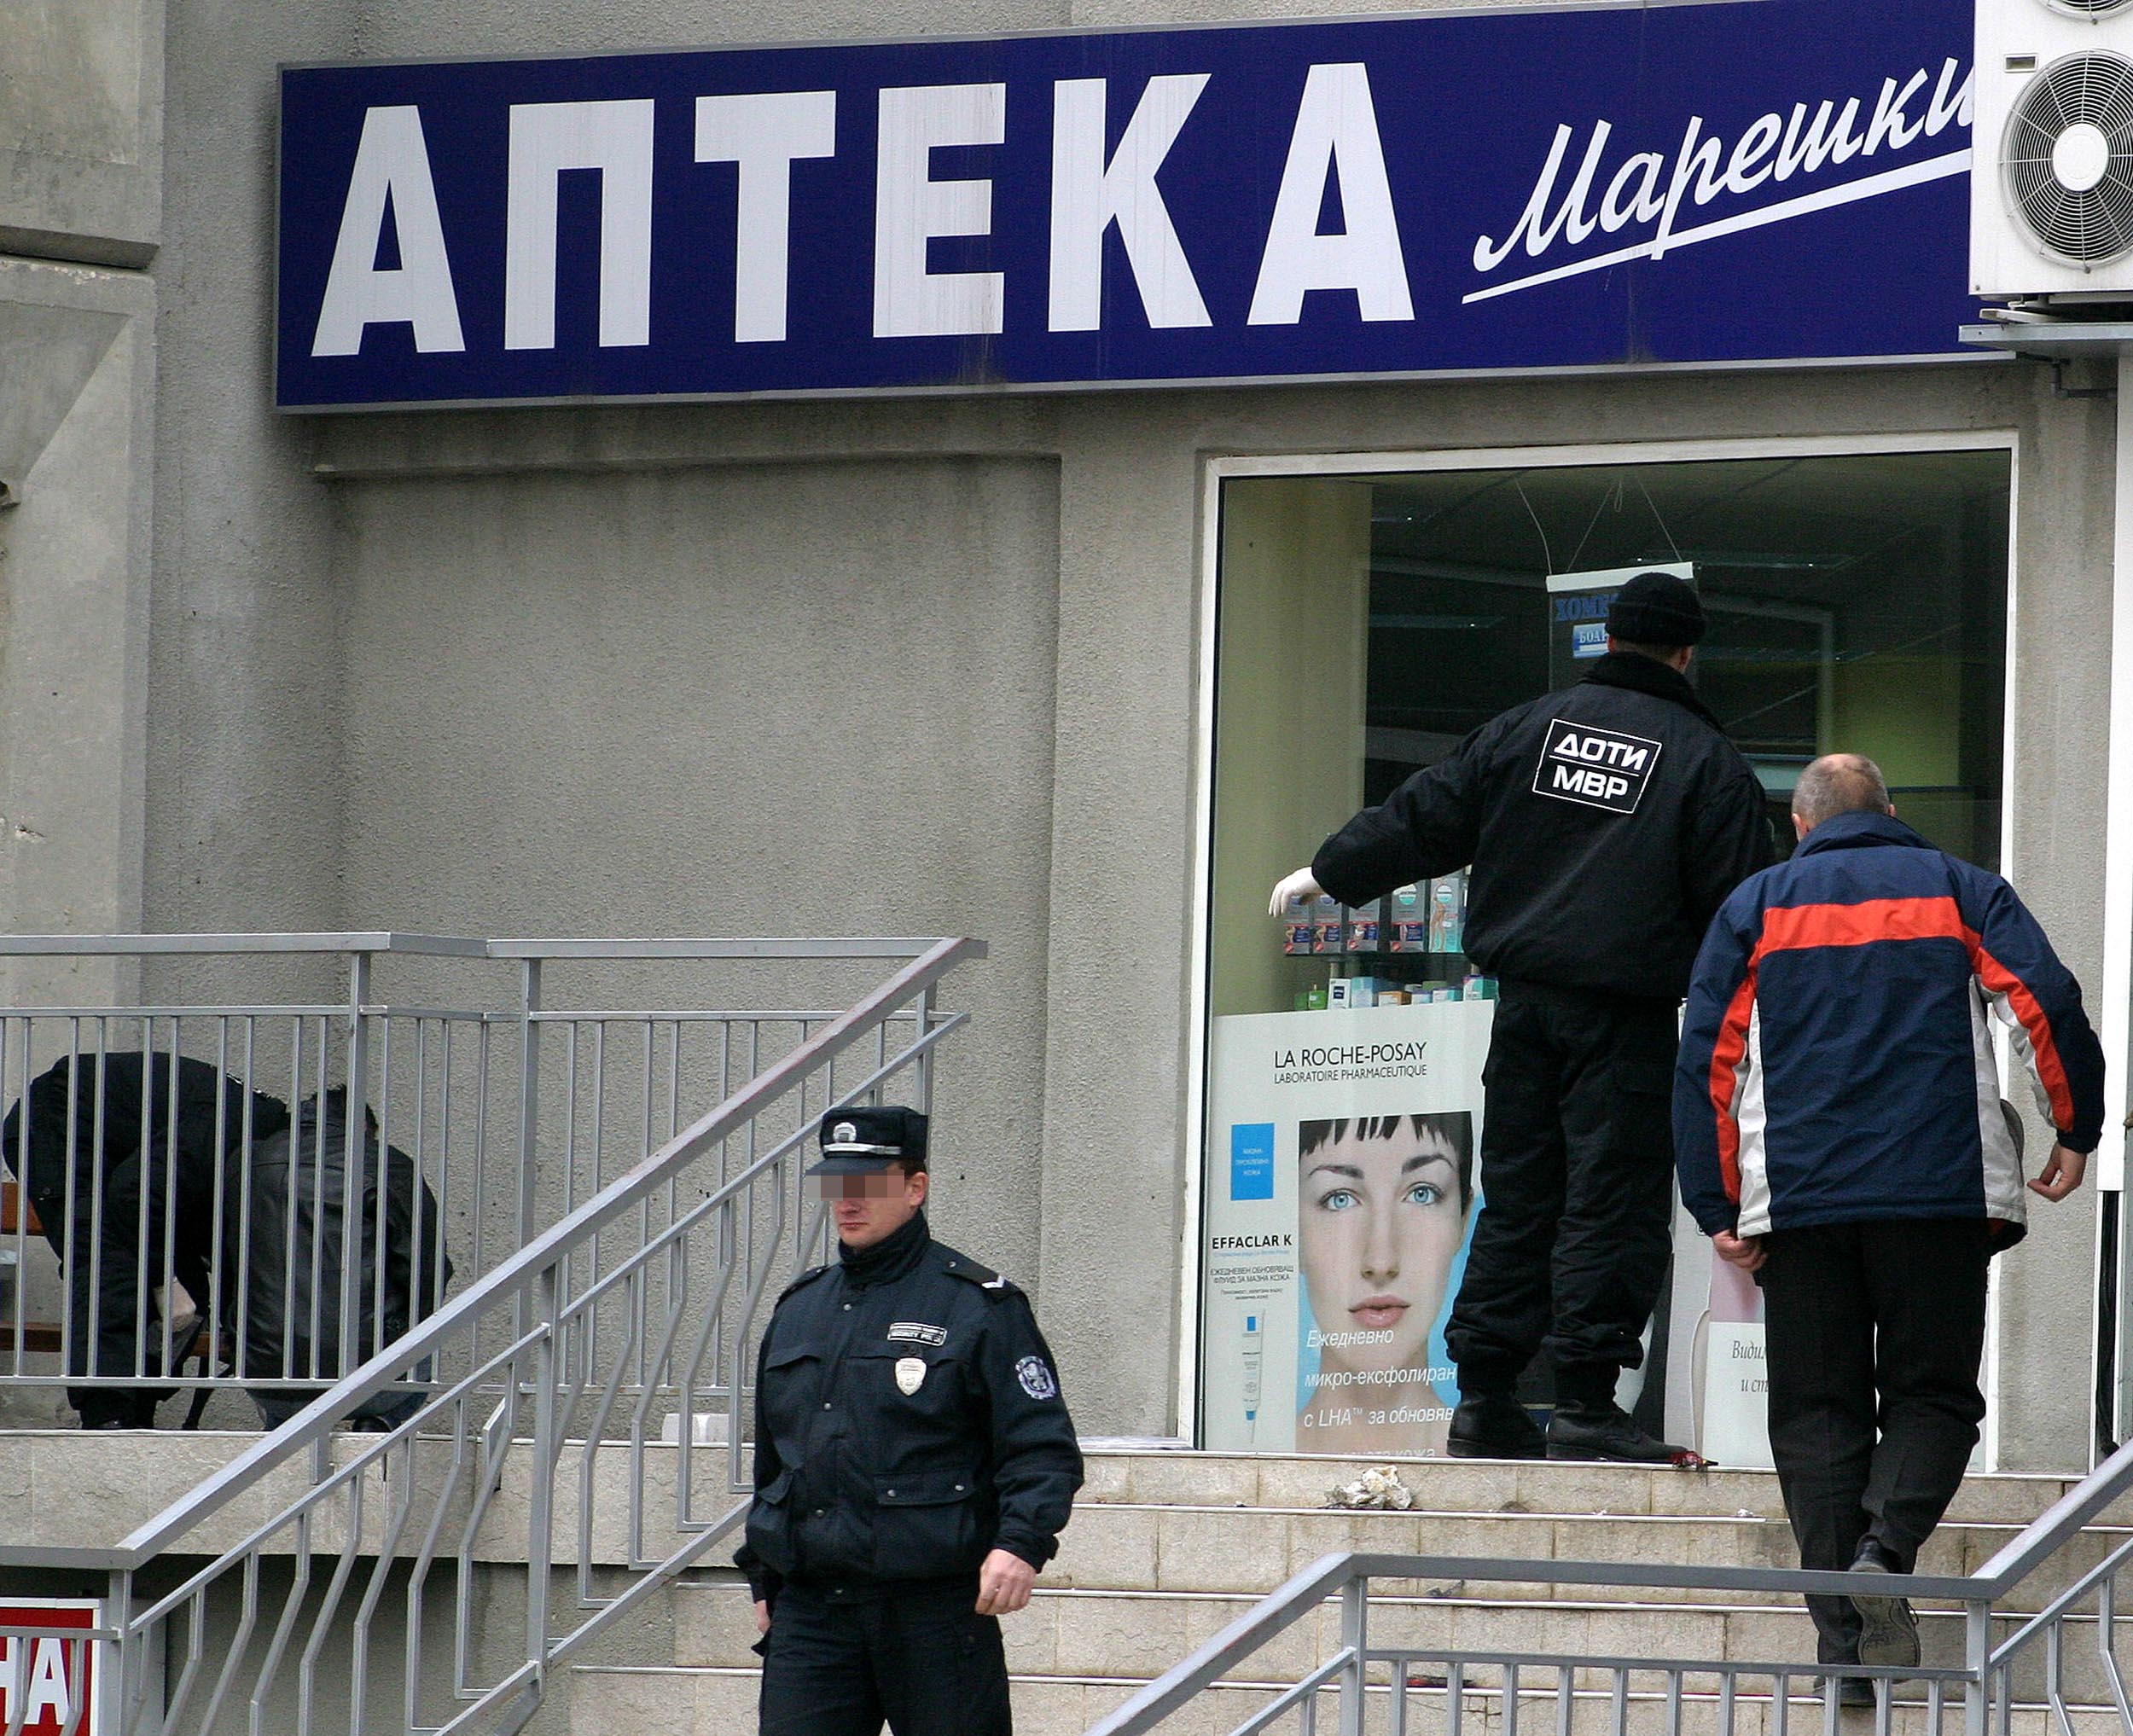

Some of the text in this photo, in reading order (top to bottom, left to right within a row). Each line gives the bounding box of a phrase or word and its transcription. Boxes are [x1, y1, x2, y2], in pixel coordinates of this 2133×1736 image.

[311, 62, 1415, 357] АПТЕКА
[1555, 592, 1619, 622] ХОМЕ
[1553, 733, 1648, 771] ДОТИ
[1552, 764, 1628, 799] МВР
[1275, 1042, 1427, 1068] LA ROCHE-POSAY
[1275, 1064, 1427, 1084] LABORATOIRE PHARMACEUTIQUE
[1212, 1234, 1292, 1249] EFFACLAR K
[1306, 1328, 1394, 1349] Ежедневно
[1305, 1367, 1456, 1388] микро-ексфолиран
[1741, 1379, 1749, 1391] и
[1368, 1409, 1385, 1425] за
[1388, 1406, 1455, 1424] обновяв
